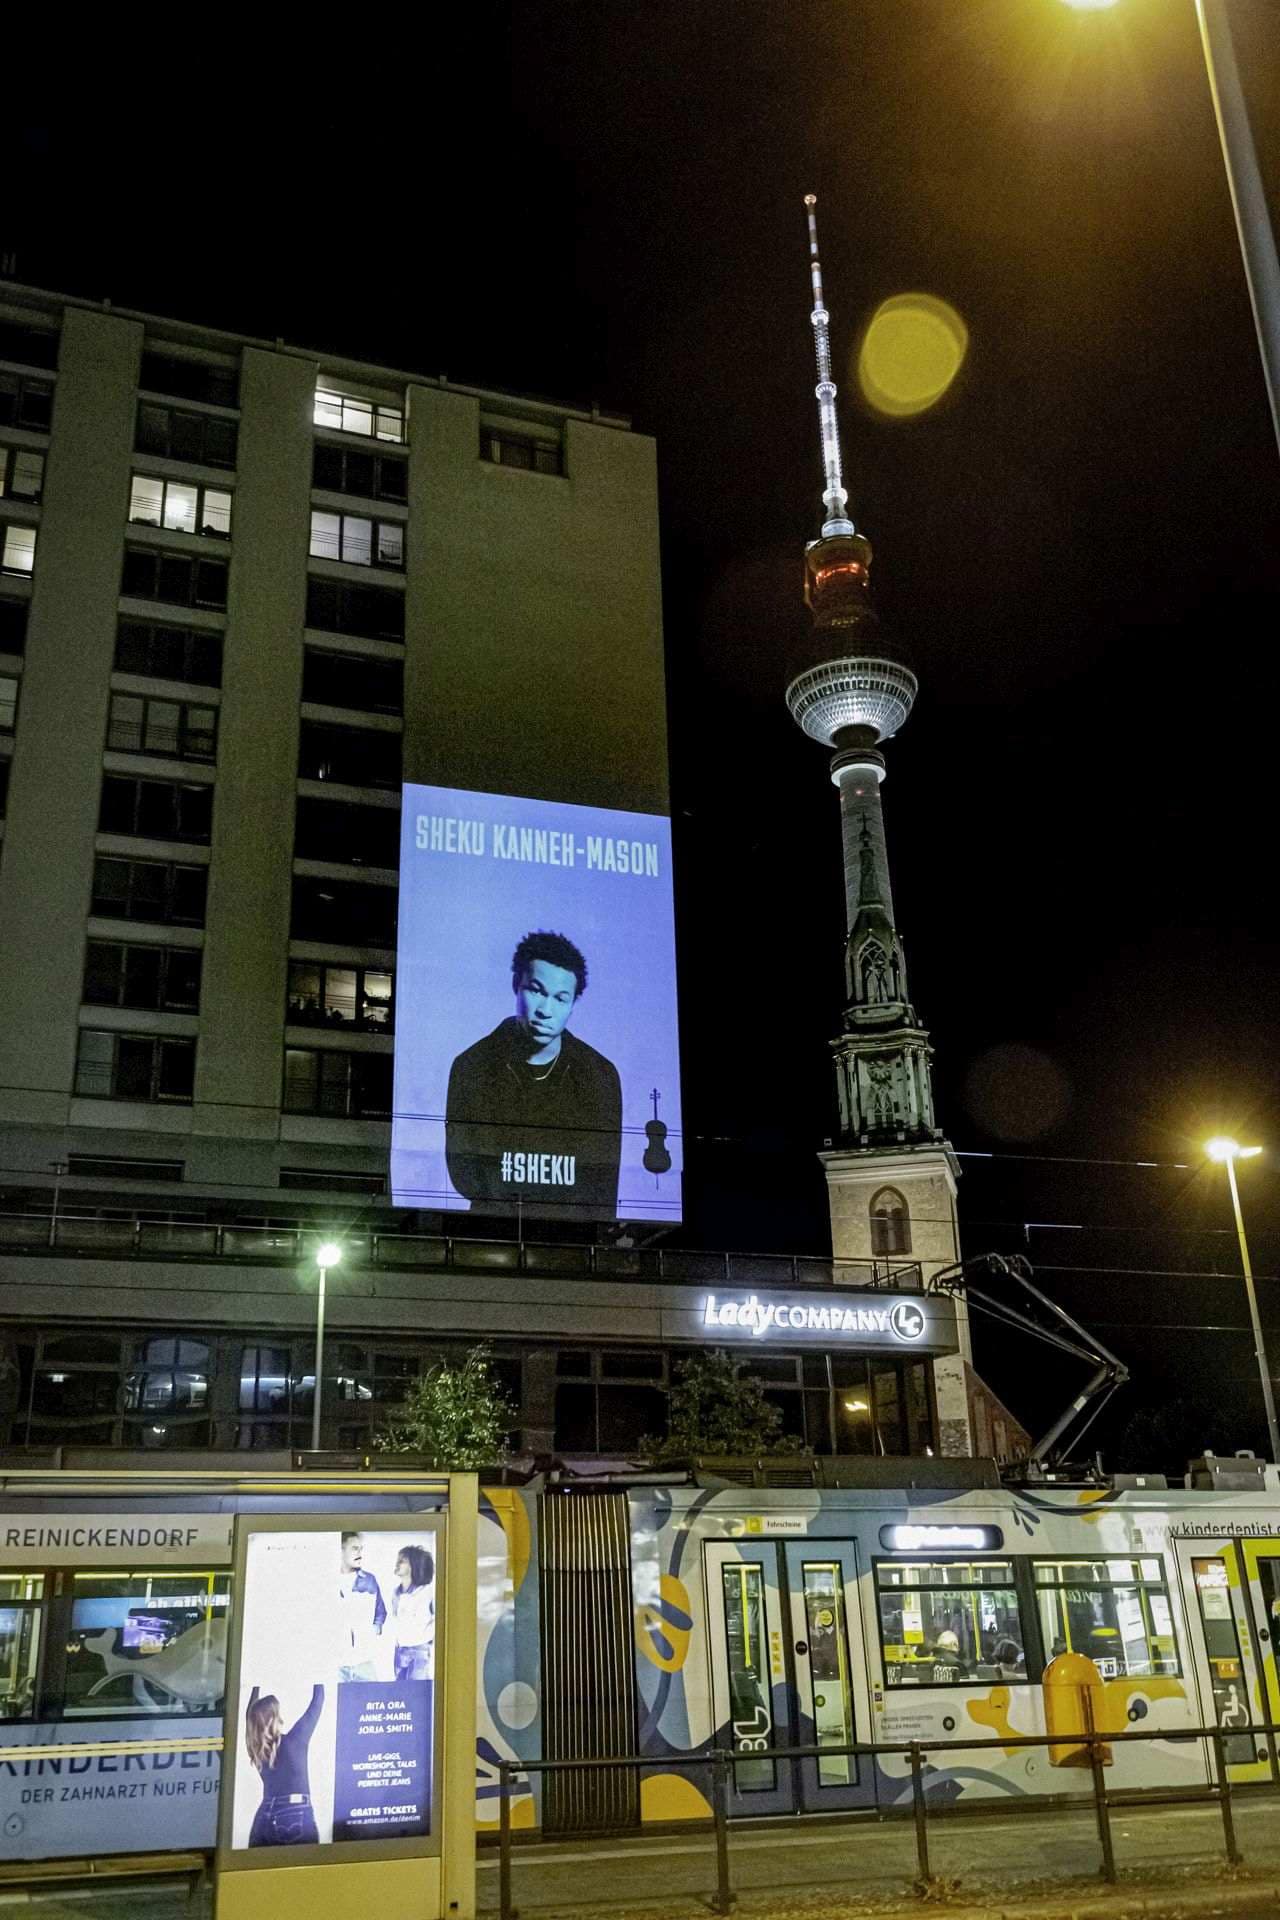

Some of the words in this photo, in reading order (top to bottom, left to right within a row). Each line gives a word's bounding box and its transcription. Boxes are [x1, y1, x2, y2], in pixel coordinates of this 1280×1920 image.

[416, 815, 485, 856] SHEKU
[493, 824, 659, 877] KANNEH-MASON
[501, 1152, 575, 1185] #SHEKU
[1145, 1521, 1280, 1536] www.kinderdentist.
[6, 1529, 198, 1547] REINICKENDORF
[366, 1702, 385, 1711] RITA
[388, 1701, 406, 1710] ORA
[360, 1712, 412, 1722] ANNE-MARIE
[358, 1725, 385, 1735] JORJA
[386, 1723, 413, 1733] SMITH
[398, 1760, 417, 1769] TALKS
[21, 1788, 54, 1804] DER
[61, 1783, 147, 1802] ZAHNARZT
[153, 1781, 186, 1796] NUR
[350, 1807, 381, 1817] GRATIS
[383, 1804, 417, 1815] TICKETS
